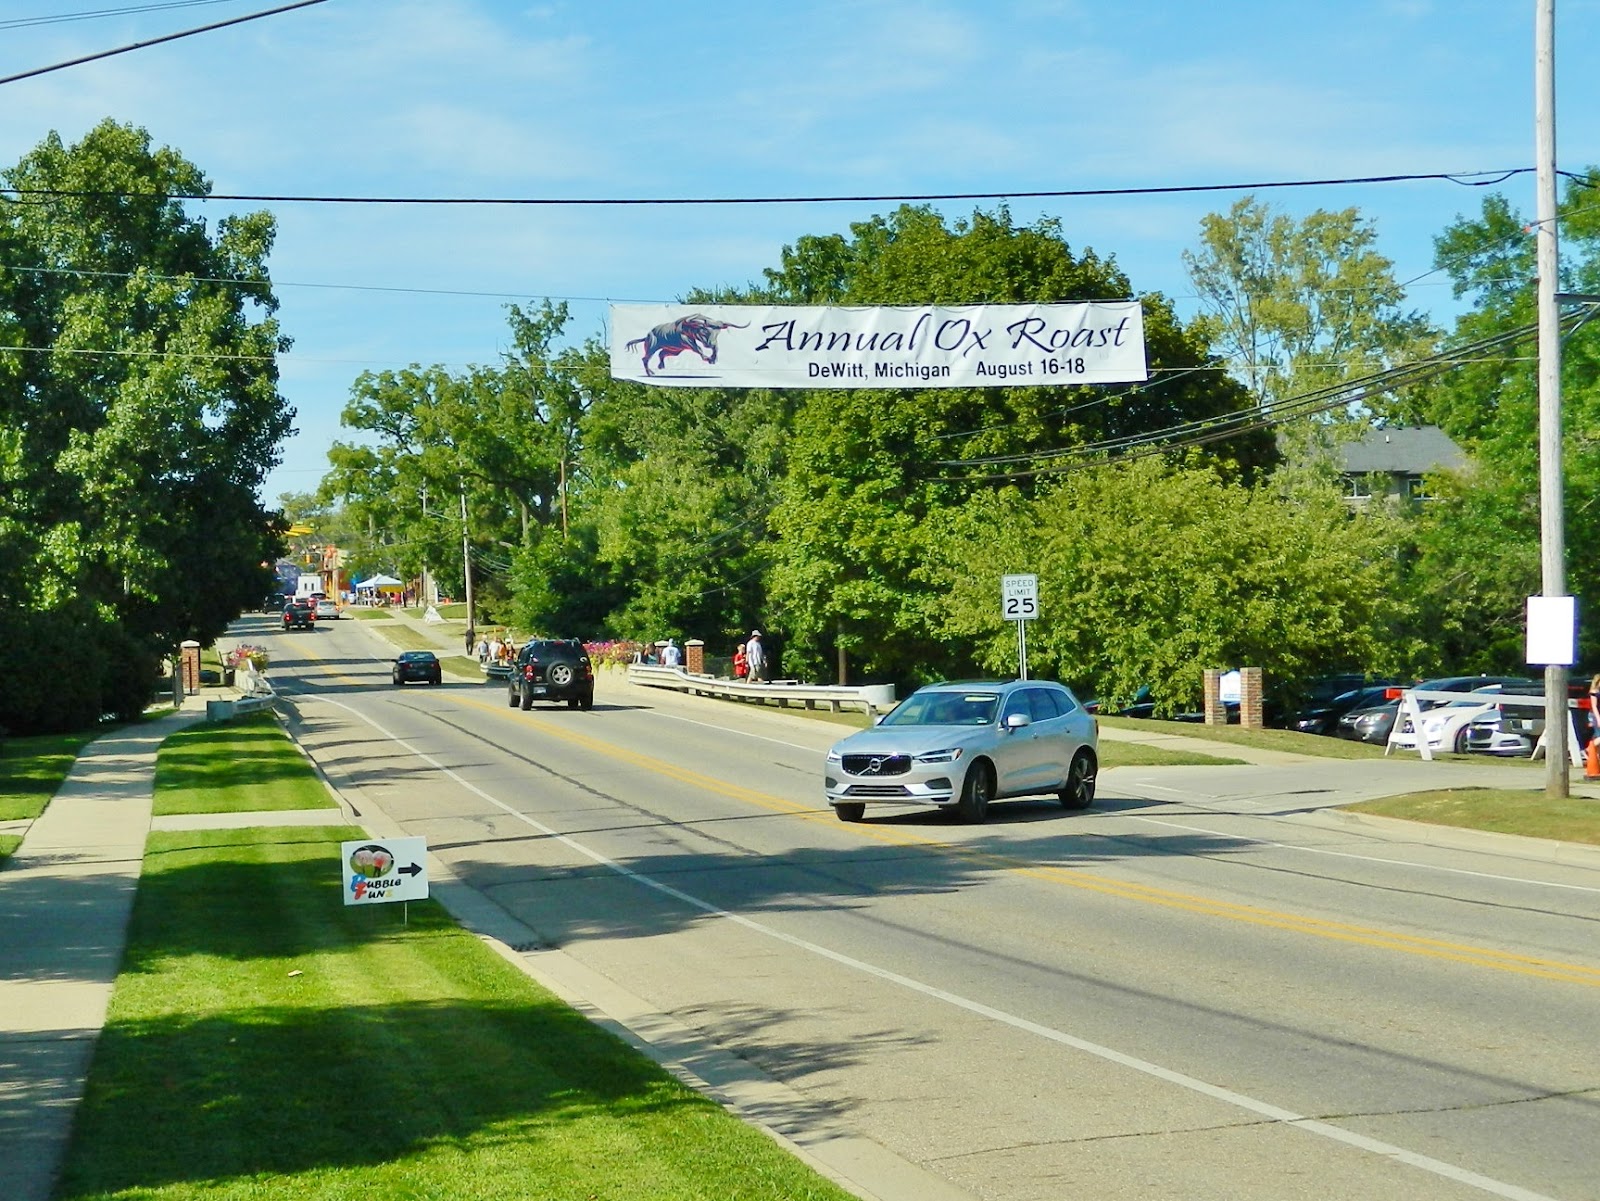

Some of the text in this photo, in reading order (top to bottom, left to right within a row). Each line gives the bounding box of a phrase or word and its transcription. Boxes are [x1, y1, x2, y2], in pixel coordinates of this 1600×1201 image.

[755, 312, 1130, 358] Annual Ox Roast
[808, 357, 1085, 381] DeWitt, Michigan August 16-18
[1005, 579, 1034, 588] SPEED
[1008, 588, 1030, 596] LIMIT
[1007, 597, 1034, 614] 25
